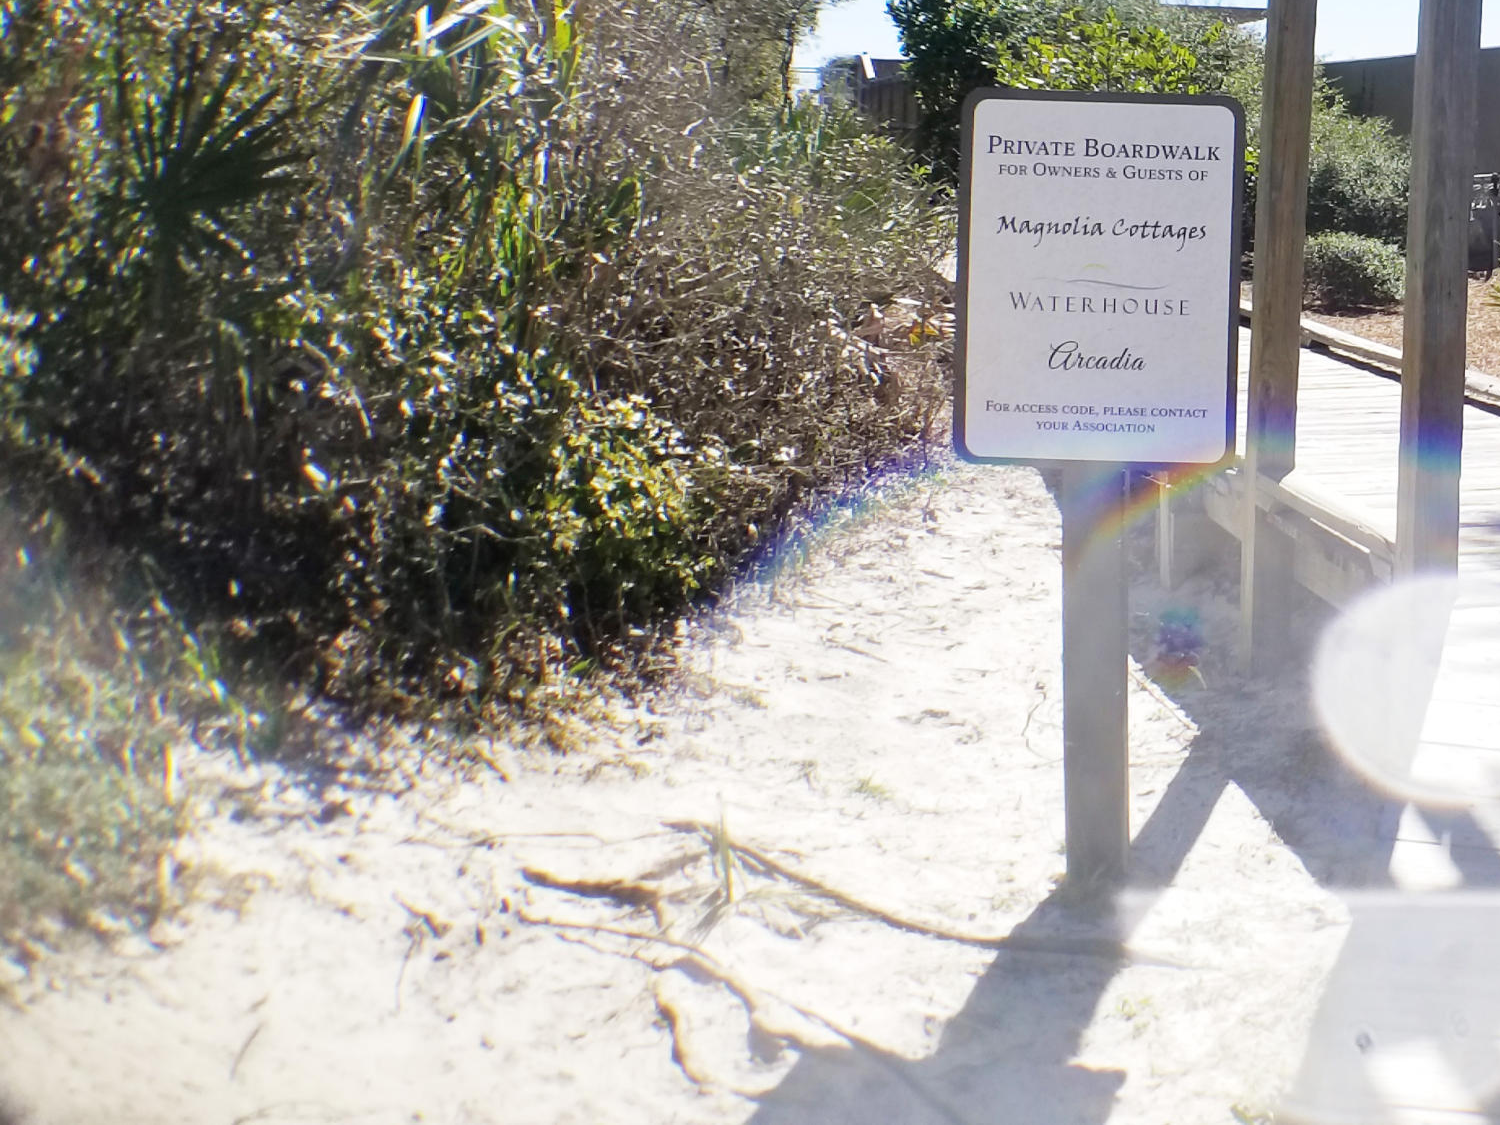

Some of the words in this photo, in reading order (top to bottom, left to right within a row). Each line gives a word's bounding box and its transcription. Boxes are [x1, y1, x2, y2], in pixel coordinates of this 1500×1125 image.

[987, 135, 1075, 156] PRIVATE
[1085, 138, 1220, 161] BOARDWALK
[999, 164, 1028, 176] FOR
[1033, 163, 1100, 178] OWNERS
[1106, 167, 1117, 178] &
[1123, 165, 1183, 180] GUESTS
[1189, 170, 1208, 181] OF
[997, 216, 1105, 247] Magnolia
[1113, 218, 1207, 251] Cottages
[1009, 292, 1191, 316] WATERHOUSE
[1048, 341, 1146, 371] Arcadia
[986, 400, 1009, 412] FOR
[1014, 403, 1058, 414] ACCESS
[1062, 405, 1099, 417] CODE,
[1103, 406, 1147, 417] PLEASE
[1151, 407, 1208, 419] CONTACT
[1036, 421, 1068, 431] YOUR
[1072, 420, 1156, 433] ASSOCIATION
